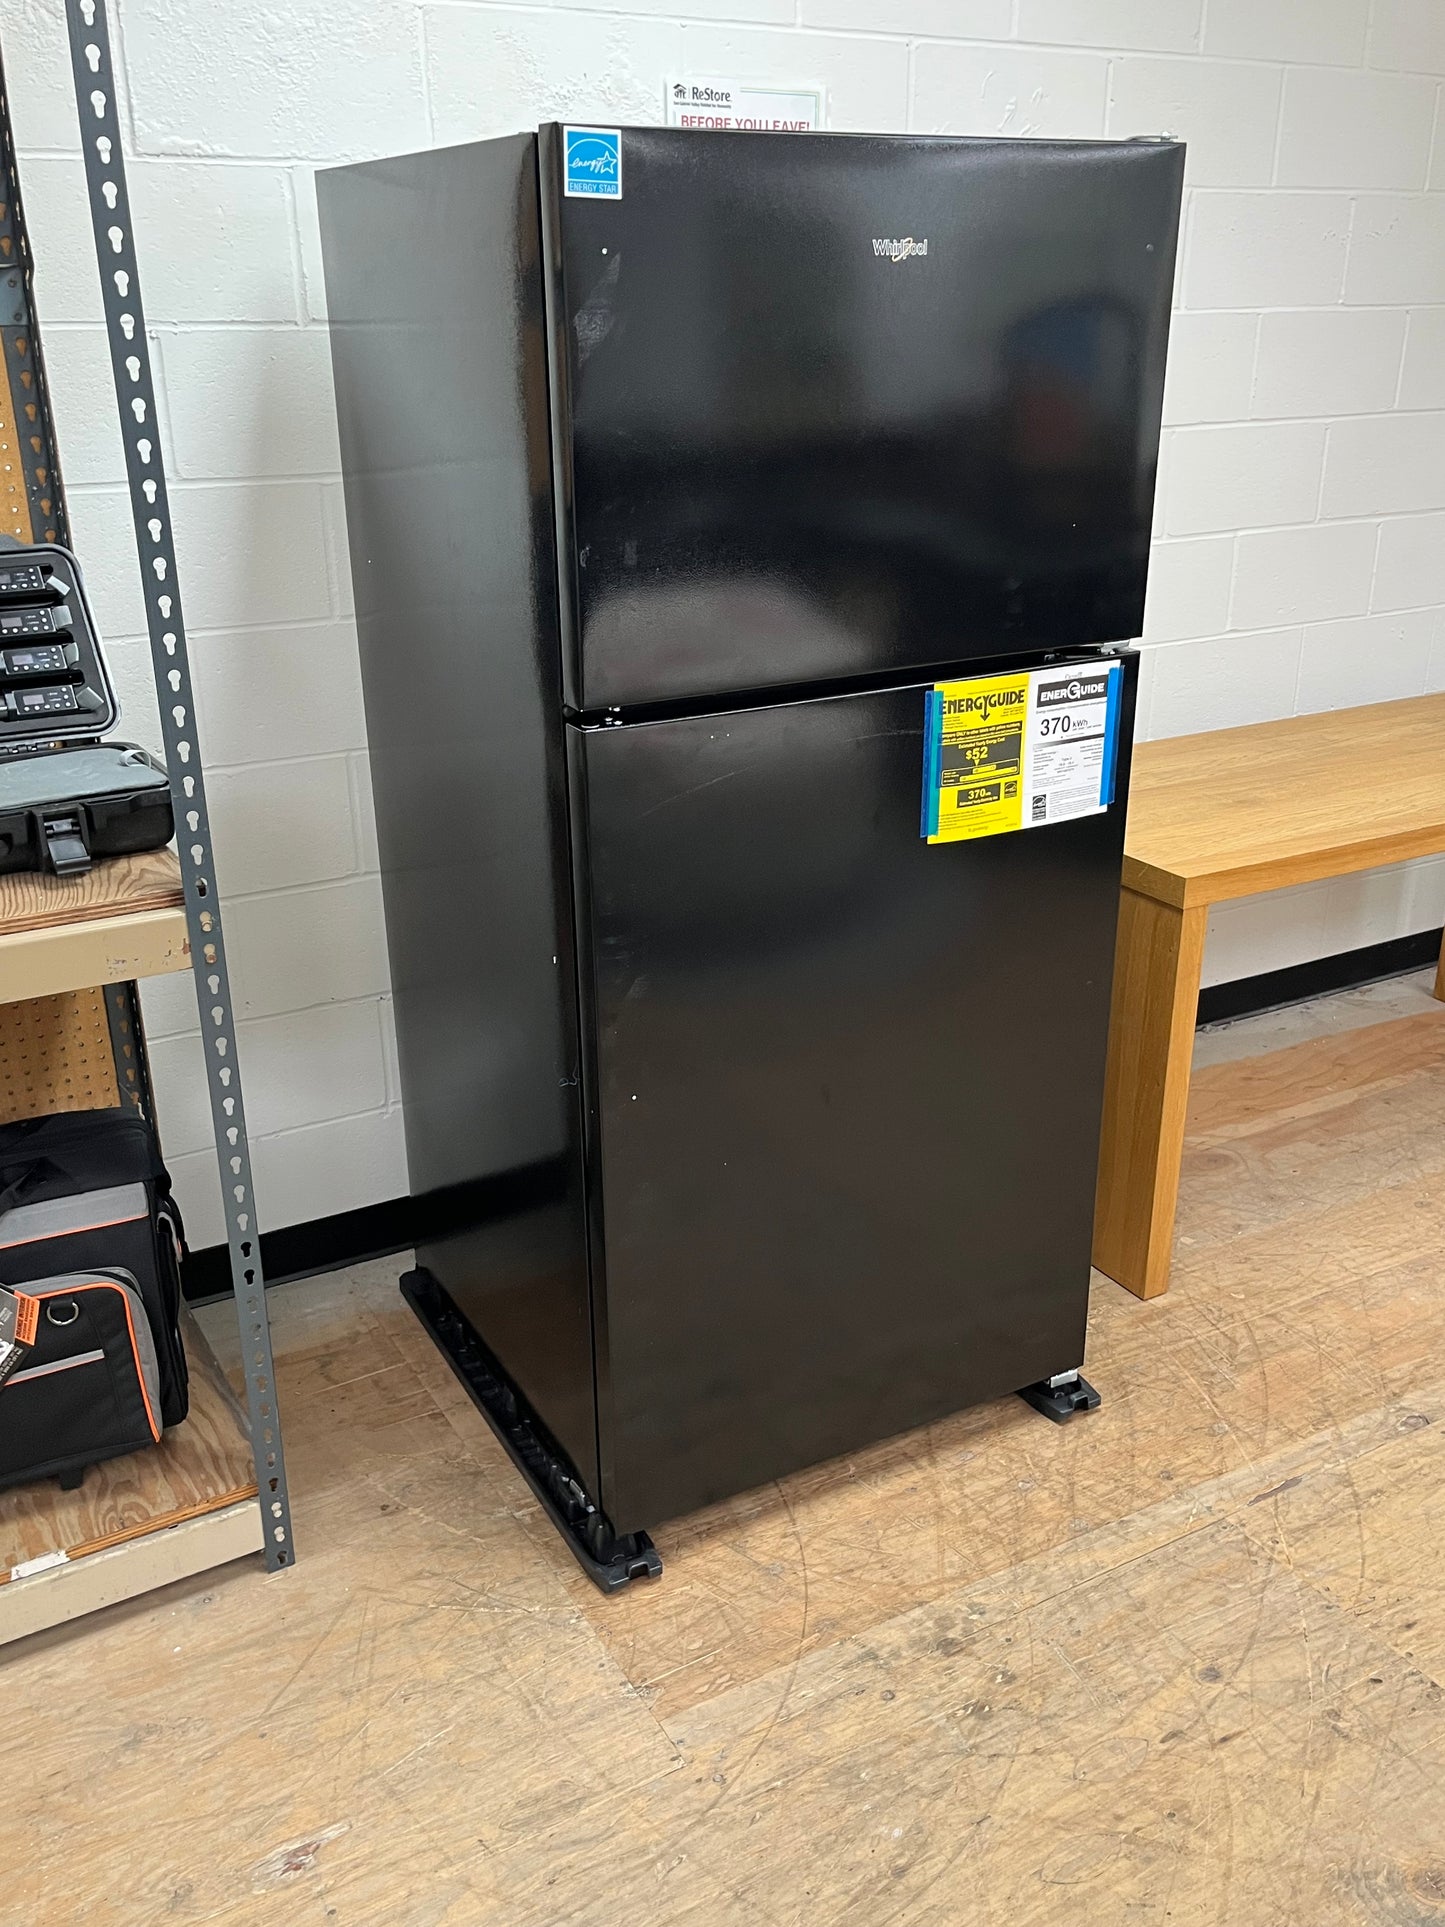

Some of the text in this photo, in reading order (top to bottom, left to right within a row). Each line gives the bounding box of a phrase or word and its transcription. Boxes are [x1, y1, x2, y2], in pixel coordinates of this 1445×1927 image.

[692, 86, 731, 102] ReStore
[681, 115, 731, 129] BEFORE
[569, 182, 616, 193] ENERGY STAR
[872, 238, 928, 261] Whirlpool
[1040, 681, 1105, 702] ENERGUIDE
[940, 689, 1026, 716] ENERGYGUIDE
[1040, 714, 1071, 737] 370
[1072, 719, 1089, 728] kWh
[965, 746, 988, 760] $52
[967, 788, 987, 800] 370
